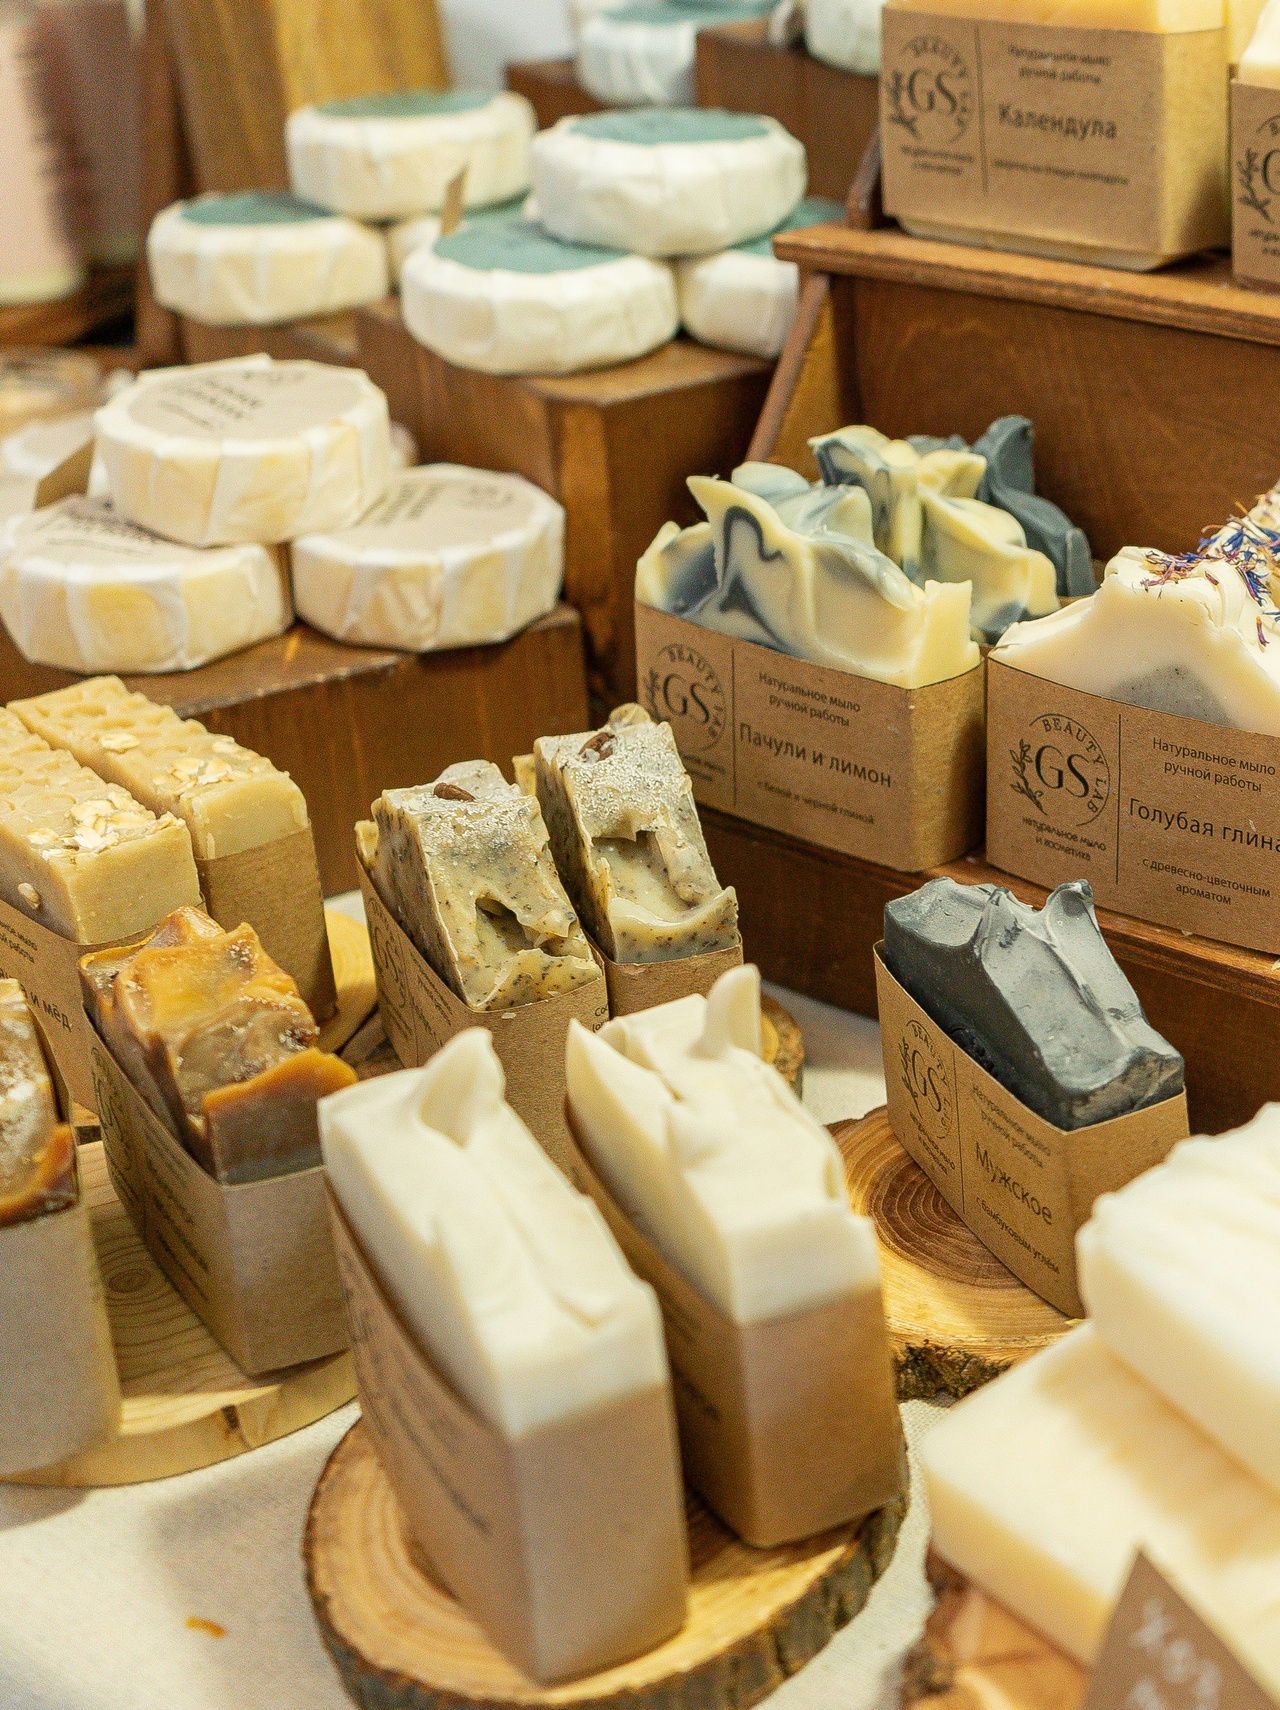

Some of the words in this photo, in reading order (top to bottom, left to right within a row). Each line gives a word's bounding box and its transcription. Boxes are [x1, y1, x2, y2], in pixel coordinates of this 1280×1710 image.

[907, 68, 958, 115] GS
[998, 102, 1118, 140] Календула
[663, 673, 710, 724] GS
[758, 671, 827, 703] Натуральное
[829, 694, 861, 713] мыло
[769, 693, 808, 714] ручной
[810, 706, 850, 727] работы
[739, 721, 808, 761] Пачули
[812, 750, 824, 767] и
[828, 755, 893, 788] лимон
[1034, 744, 1091, 798] GS
[1043, 718, 1106, 765] BEAUTY
[1087, 776, 1108, 813] LAB
[1152, 737, 1237, 769] Натуральное
[1239, 758, 1276, 776] мыло
[1163, 759, 1211, 783] ручной
[1214, 770, 1262, 794] работы
[1128, 797, 1214, 838] Голубая
[1150, 857, 1271, 898] древесно-цветочным
[1175, 881, 1232, 906] ароматом
[42, 1000, 72, 1033] мёд
[974, 1141, 1054, 1226] Мужское
